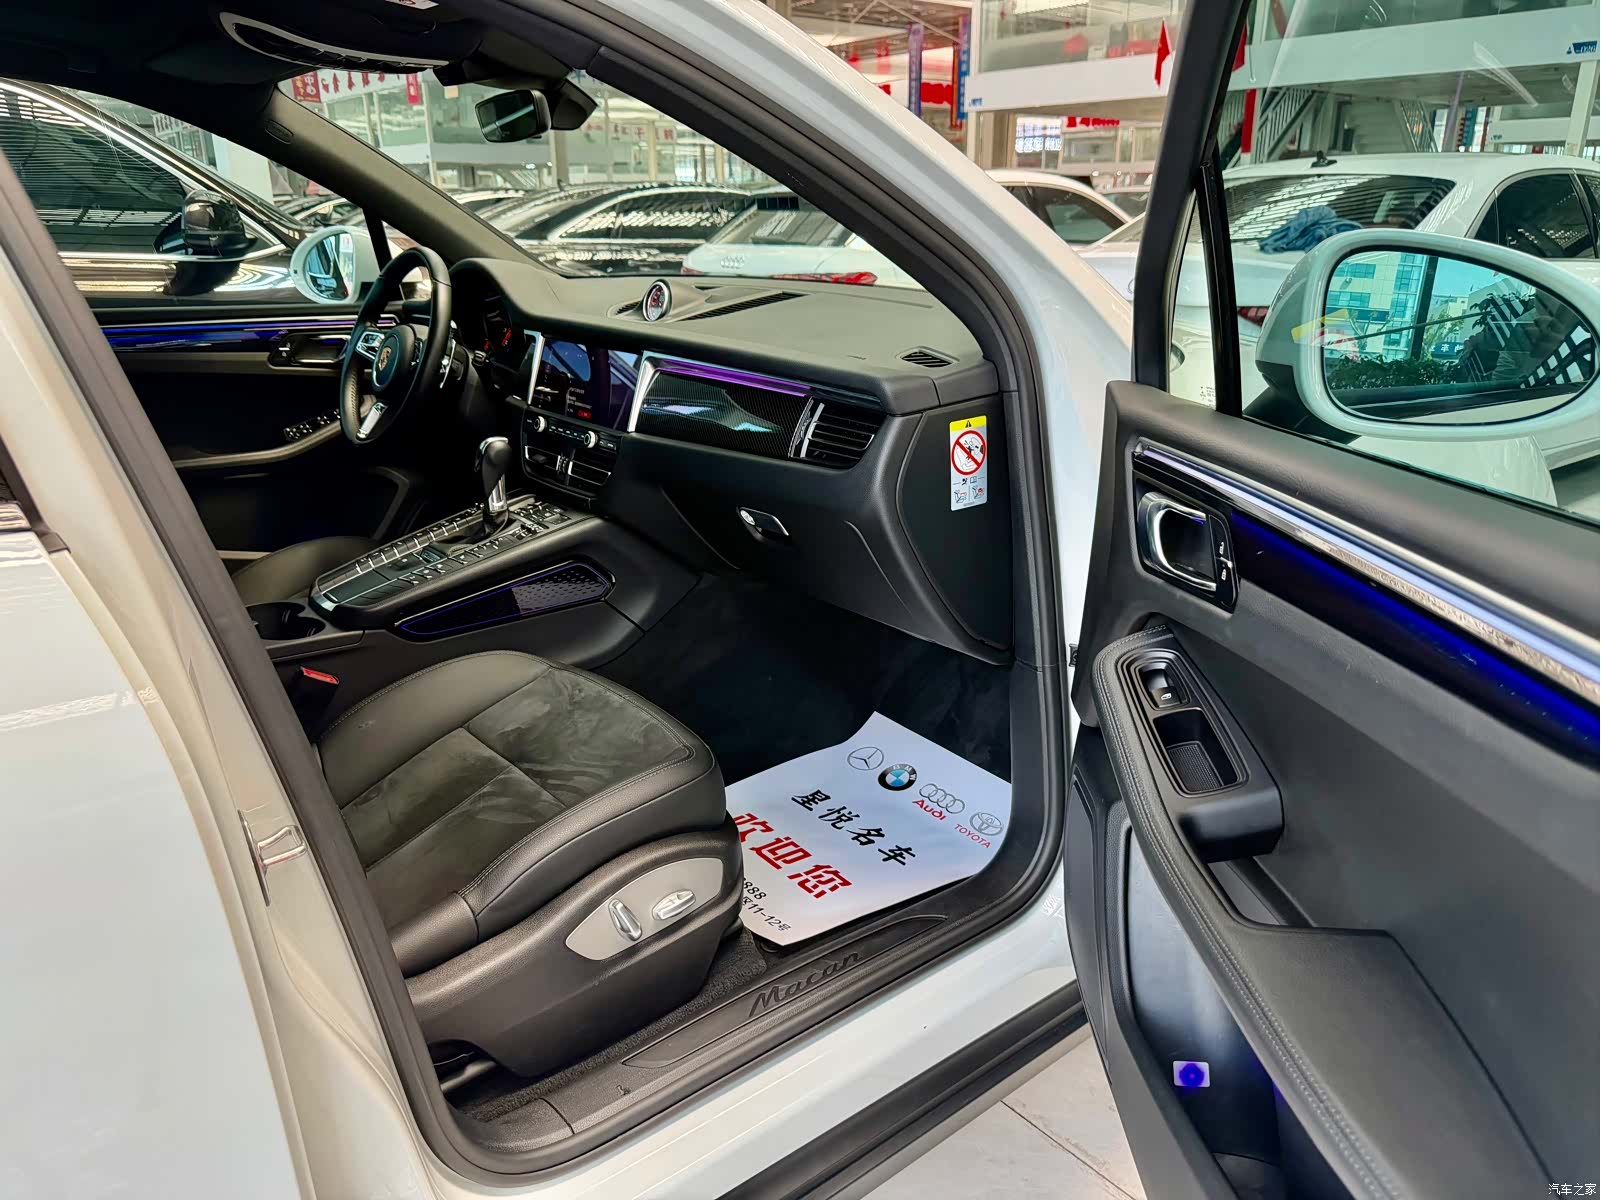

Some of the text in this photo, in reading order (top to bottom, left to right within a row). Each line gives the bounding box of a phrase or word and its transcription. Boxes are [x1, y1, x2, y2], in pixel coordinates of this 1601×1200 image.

[791, 789, 916, 866] 星悦名车
[911, 799, 947, 821] Audi
[733, 812, 853, 900] 欢迎您
[953, 823, 991, 849] TOYOTA
[743, 877, 767, 900] 888
[749, 951, 860, 1017] Macan
